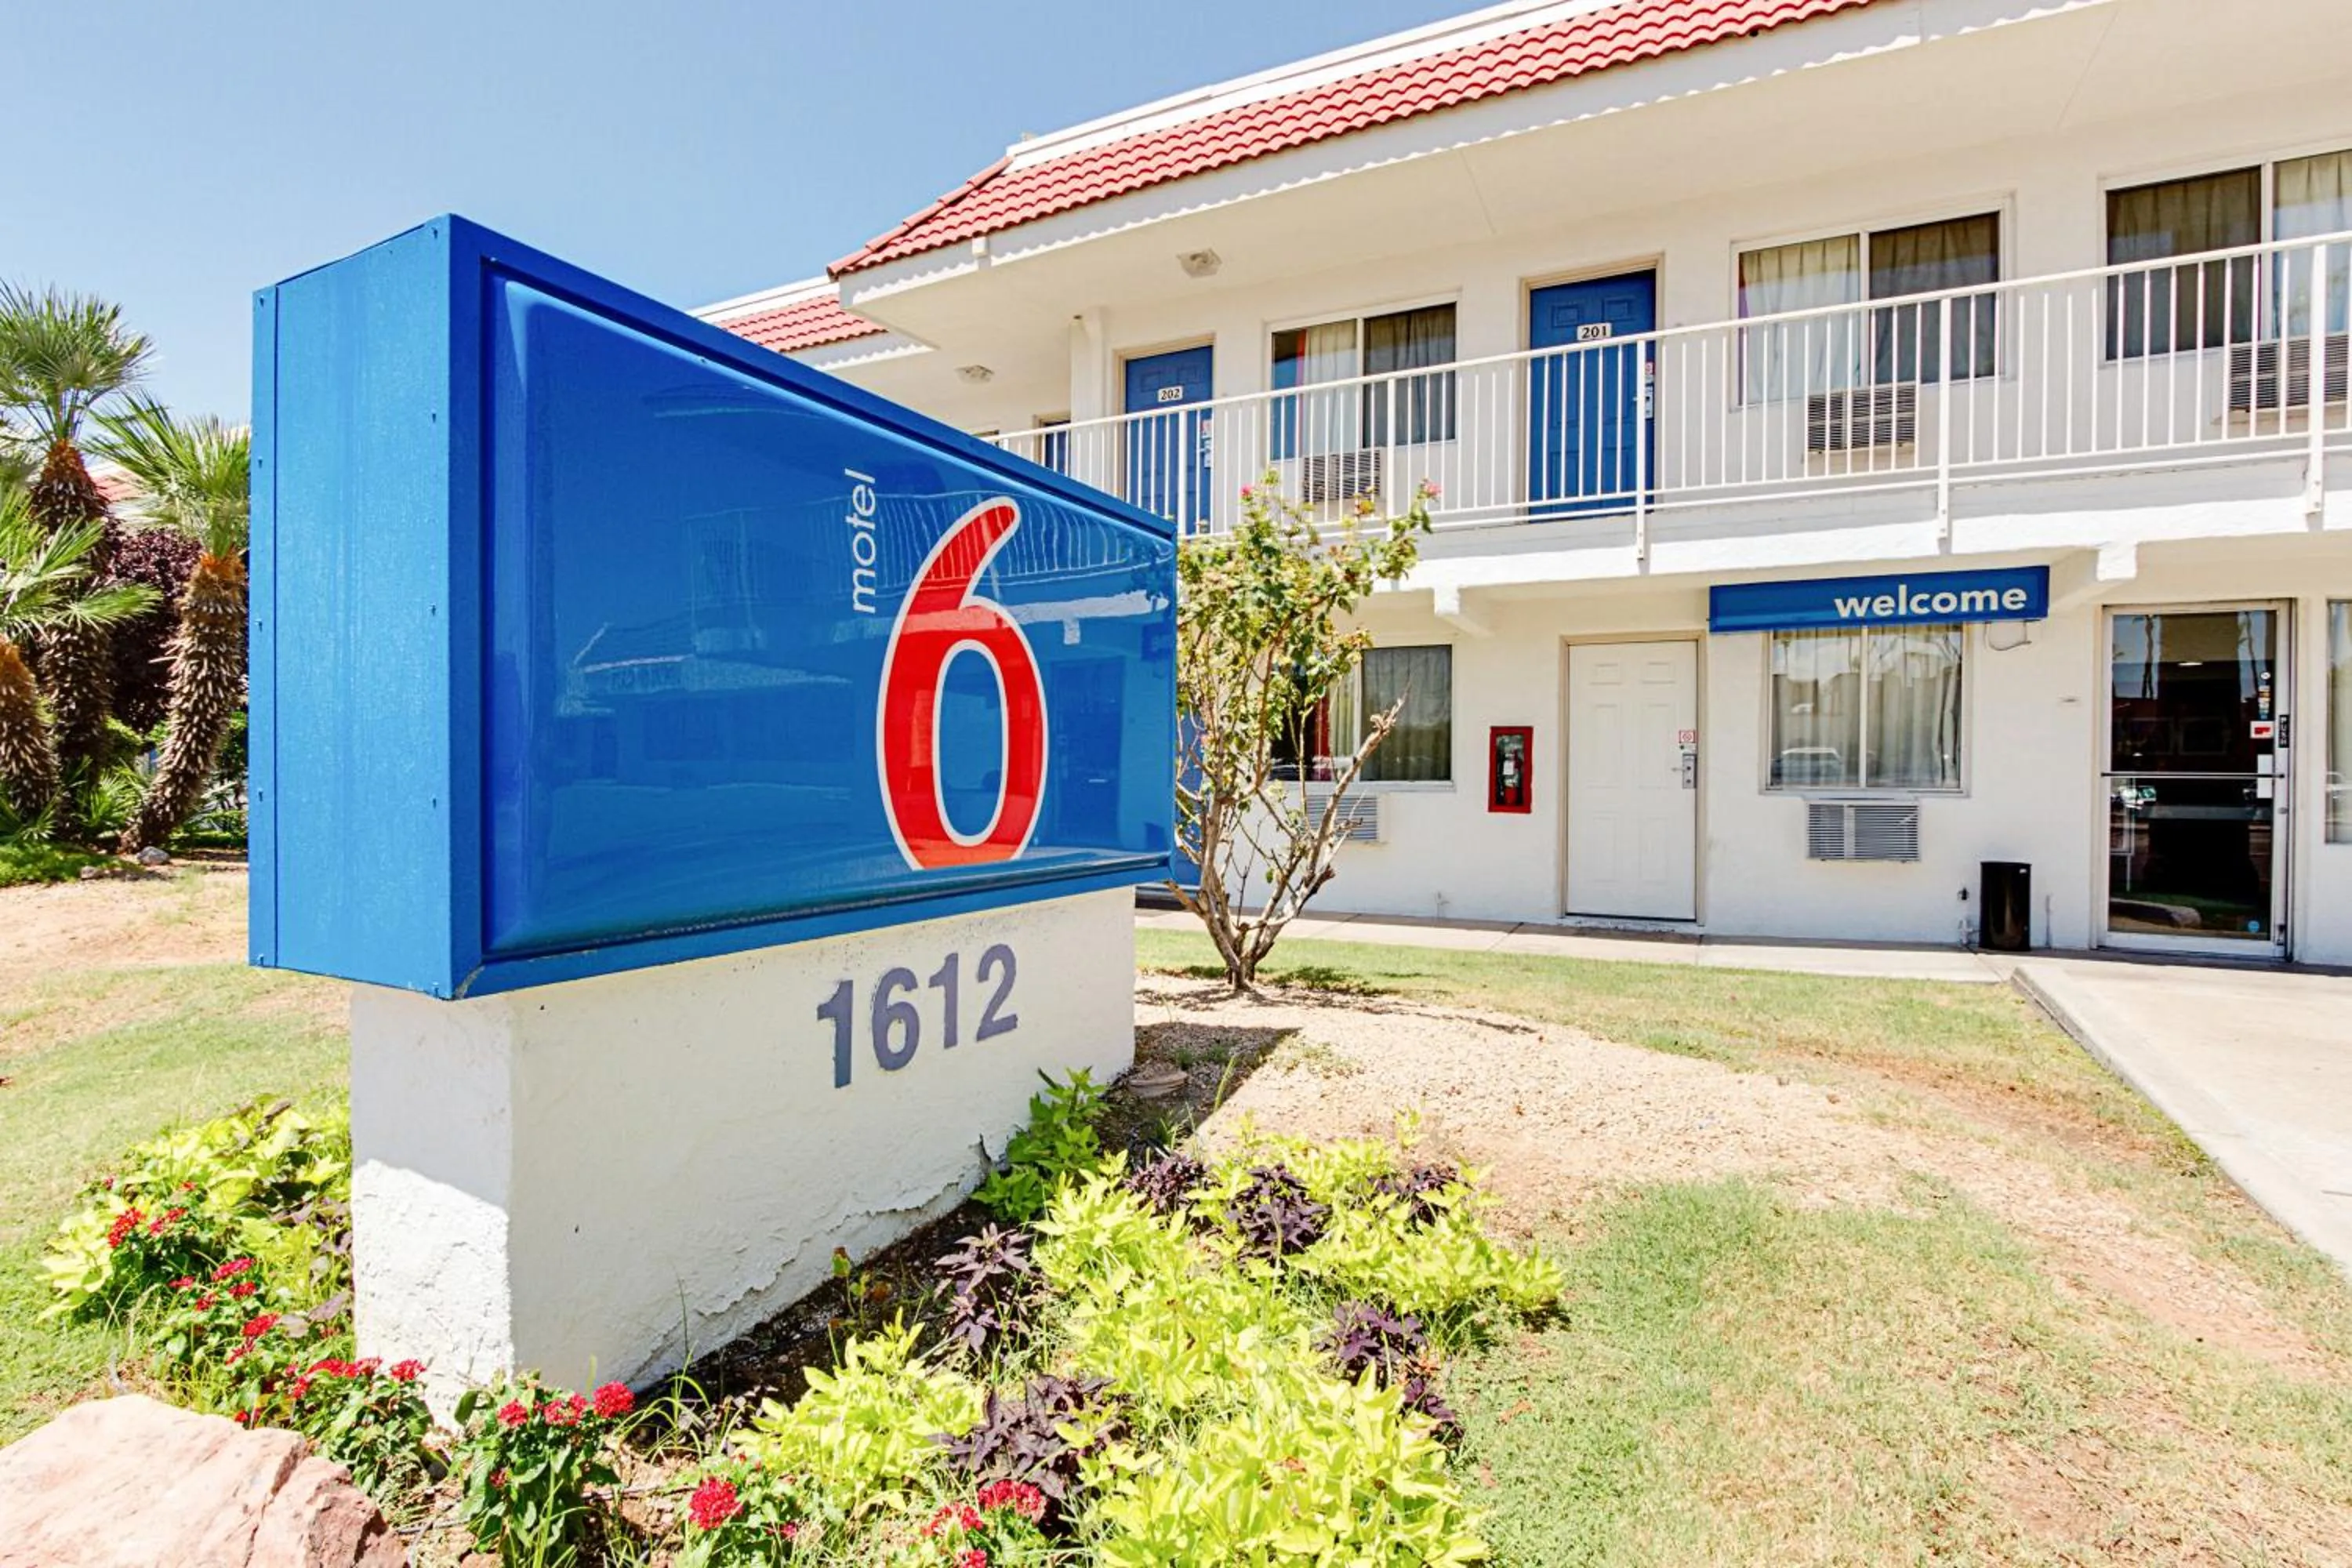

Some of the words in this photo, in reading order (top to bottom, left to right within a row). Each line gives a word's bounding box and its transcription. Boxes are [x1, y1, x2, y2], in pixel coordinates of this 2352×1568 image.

[1581, 325, 1606, 339] 201
[1161, 388, 1180, 400] 202
[844, 468, 877, 614] motel
[1834, 584, 2027, 618] welcome
[876, 496, 1049, 871] 6
[816, 943, 1018, 1088] 1612
